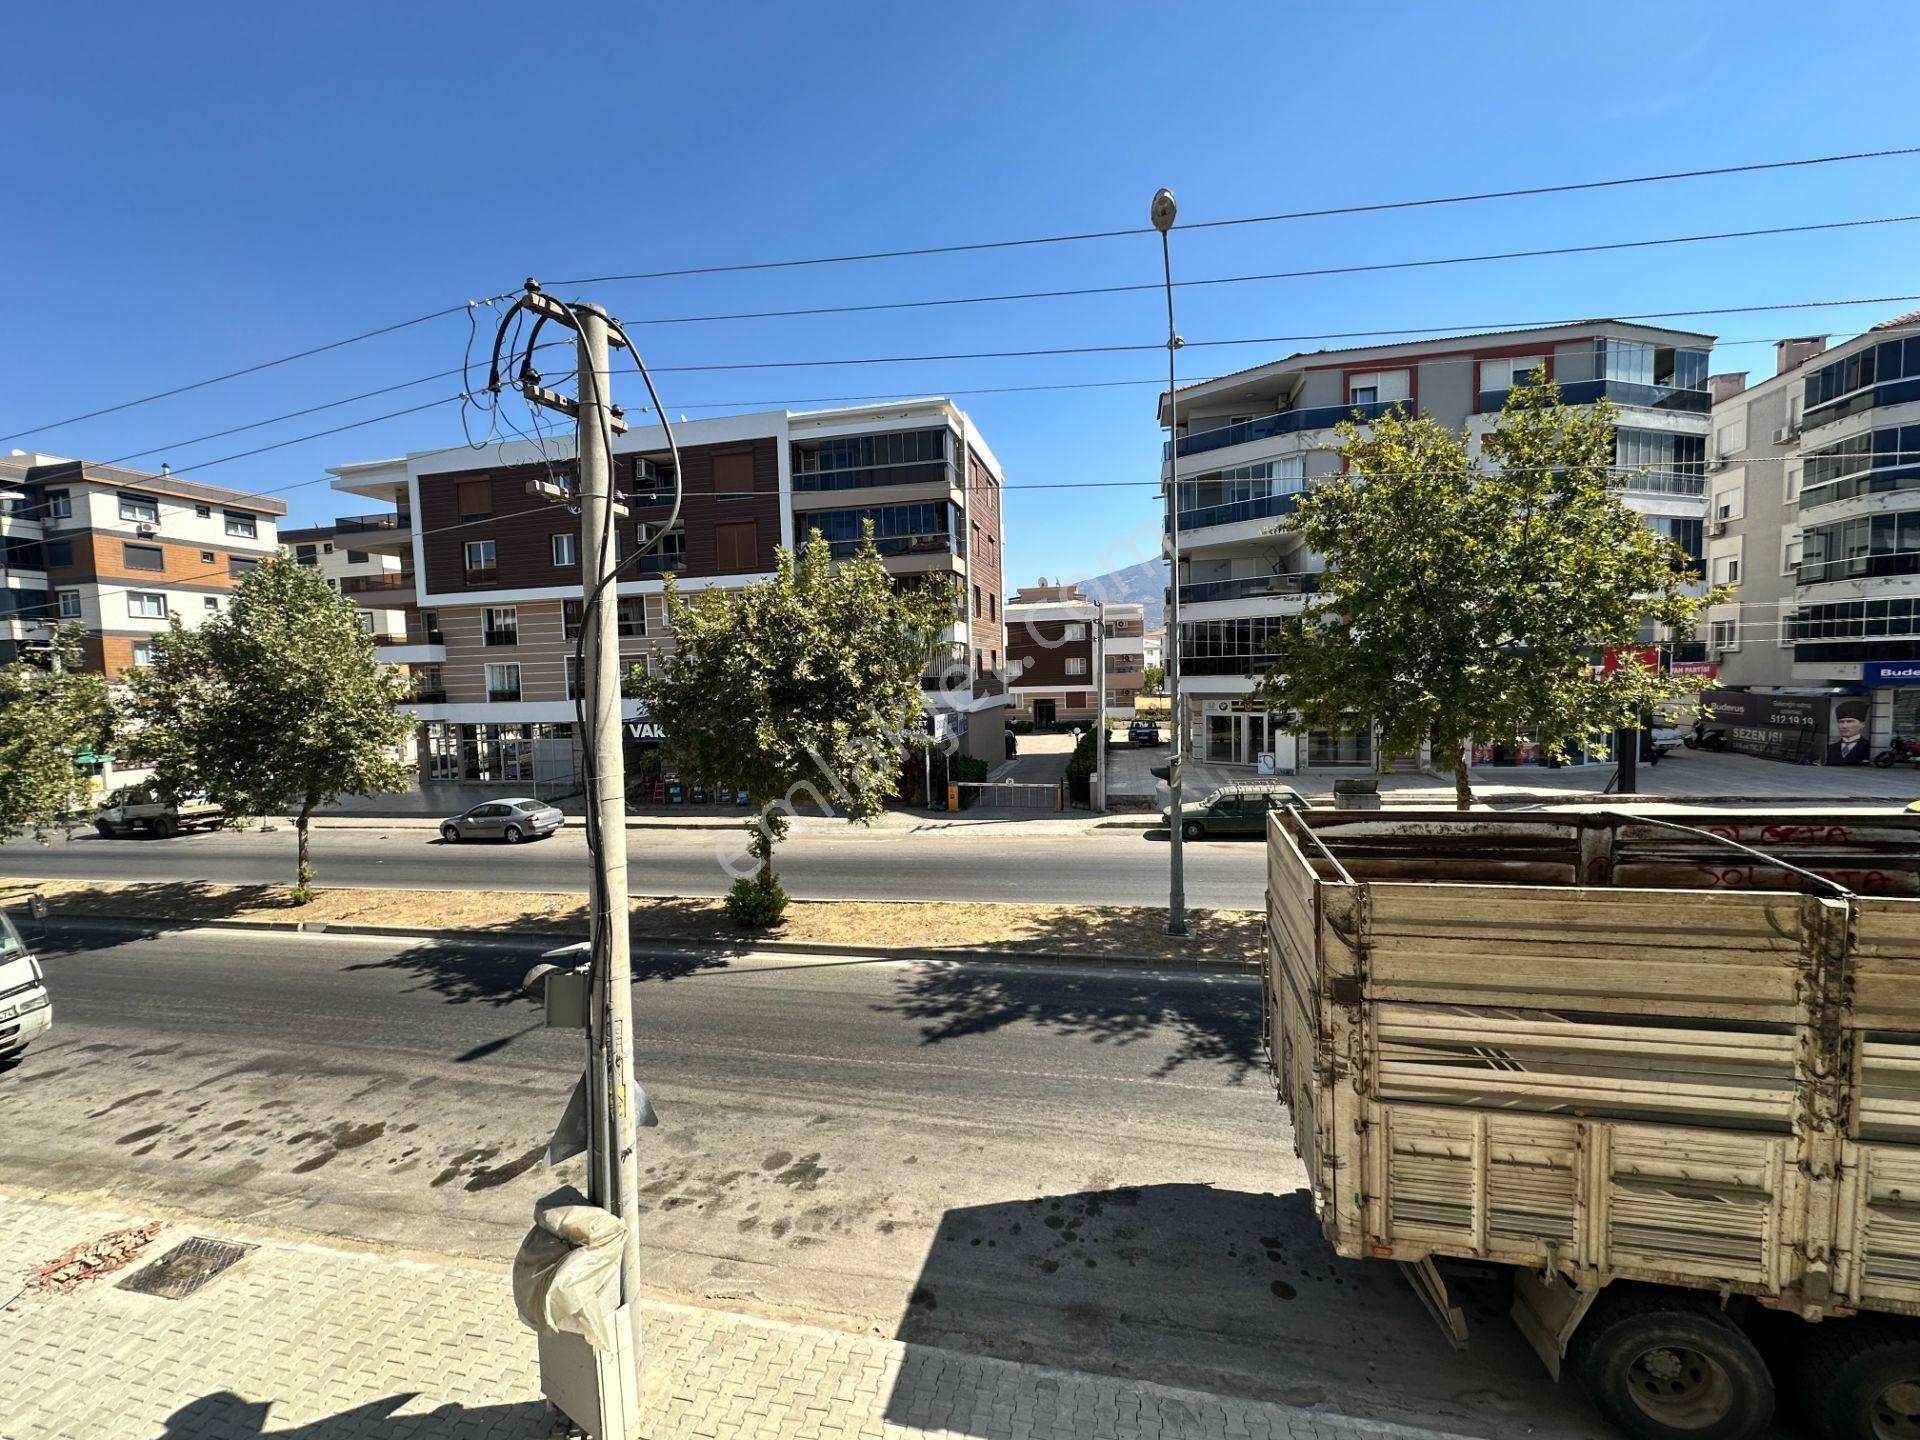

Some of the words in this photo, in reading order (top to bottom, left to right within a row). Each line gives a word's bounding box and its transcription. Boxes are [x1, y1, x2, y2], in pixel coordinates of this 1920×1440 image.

[1710, 702, 1745, 713] Buderus
[1770, 714, 1786, 724] 512
[1788, 715, 1800, 724] 19
[1802, 716, 1814, 725] 19
[1732, 727, 1766, 741] SEZEN
